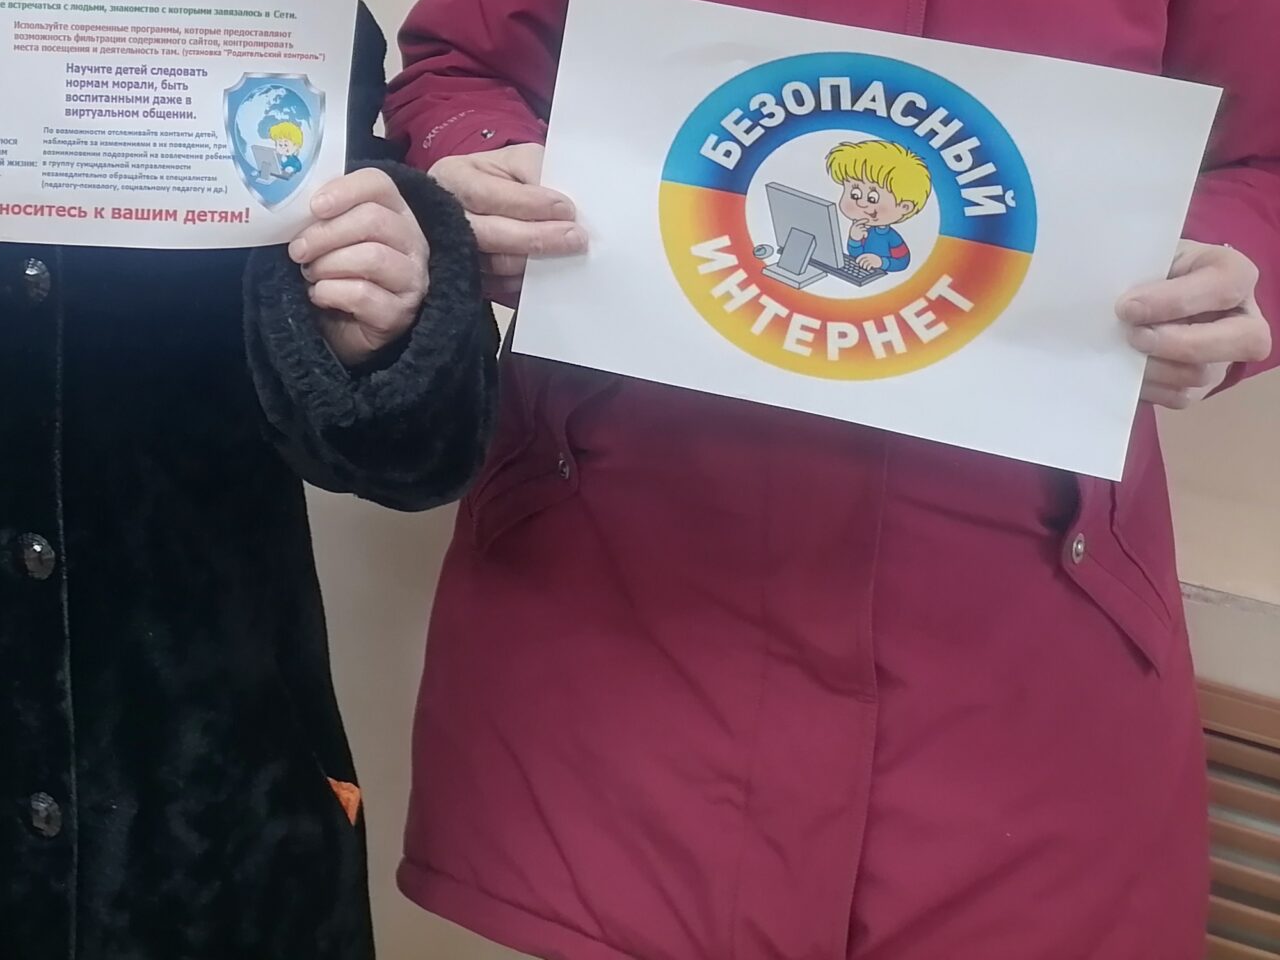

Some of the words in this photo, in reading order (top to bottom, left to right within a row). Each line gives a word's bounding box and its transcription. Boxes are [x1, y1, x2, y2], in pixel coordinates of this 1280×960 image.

[7, 0, 61, 11] встречаться
[70, 2, 107, 13] людьми,
[109, 4, 159, 13] знакомство
[167, 6, 211, 17] которыми
[213, 8, 262, 17] завязалось
[273, 8, 297, 19] Сети.
[13, 19, 68, 33] Используйте
[69, 23, 128, 34] современные
[130, 25, 181, 36] программы,
[183, 27, 221, 37] которые
[223, 28, 290, 38] предоставляют
[13, 32, 71, 42] возможность
[73, 32, 126, 46] фильтрации
[127, 37, 186, 47] содержимого
[188, 36, 220, 48] сайтов,
[222, 39, 293, 50] контролировать
[65, 63, 112, 77] Научите
[114, 65, 147, 76] детей
[150, 68, 207, 78] следовать
[65, 80, 108, 91] нормам
[111, 81, 157, 92] морали,
[160, 79, 188, 90] быть
[65, 95, 149, 104] воспитанными
[152, 96, 182, 106] даже
[185, 96, 191, 104] в
[64, 109, 139, 120] виртуальном
[142, 108, 196, 120] общении.
[699, 76, 1016, 217] БЕЗОПАСНЫЙ
[93, 207, 104, 218] к
[110, 208, 177, 221] вашим
[183, 208, 249, 223] детям!
[690, 234, 975, 361] ИНТЕРНЕТ
